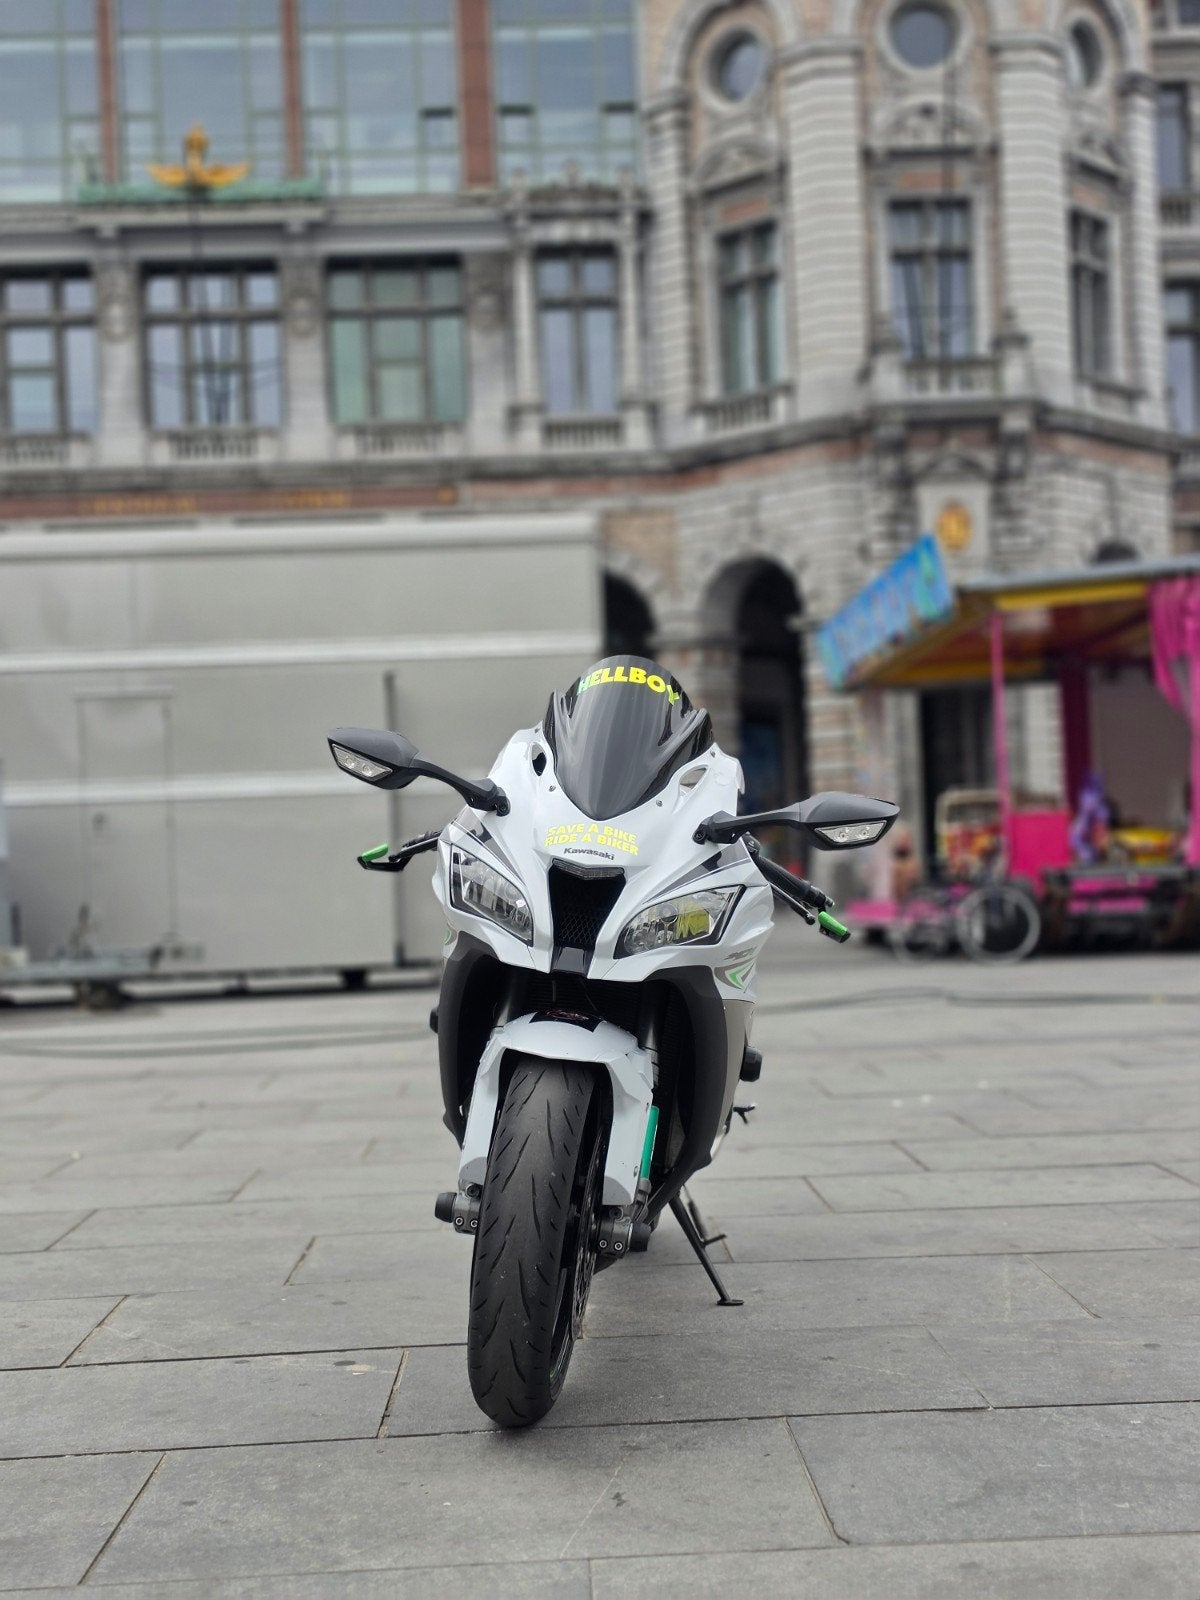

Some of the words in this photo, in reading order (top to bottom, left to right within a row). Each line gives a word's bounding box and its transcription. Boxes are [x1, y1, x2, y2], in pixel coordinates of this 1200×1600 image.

[577, 666, 680, 706] HELLBOY
[545, 833, 577, 848] RIDE
[582, 832, 592, 842] A
[597, 834, 639, 856] BIKER
[548, 823, 585, 836] SAVE
[588, 823, 599, 833] A
[603, 825, 637, 844] BIKE
[563, 847, 615, 861] Kawasaki
